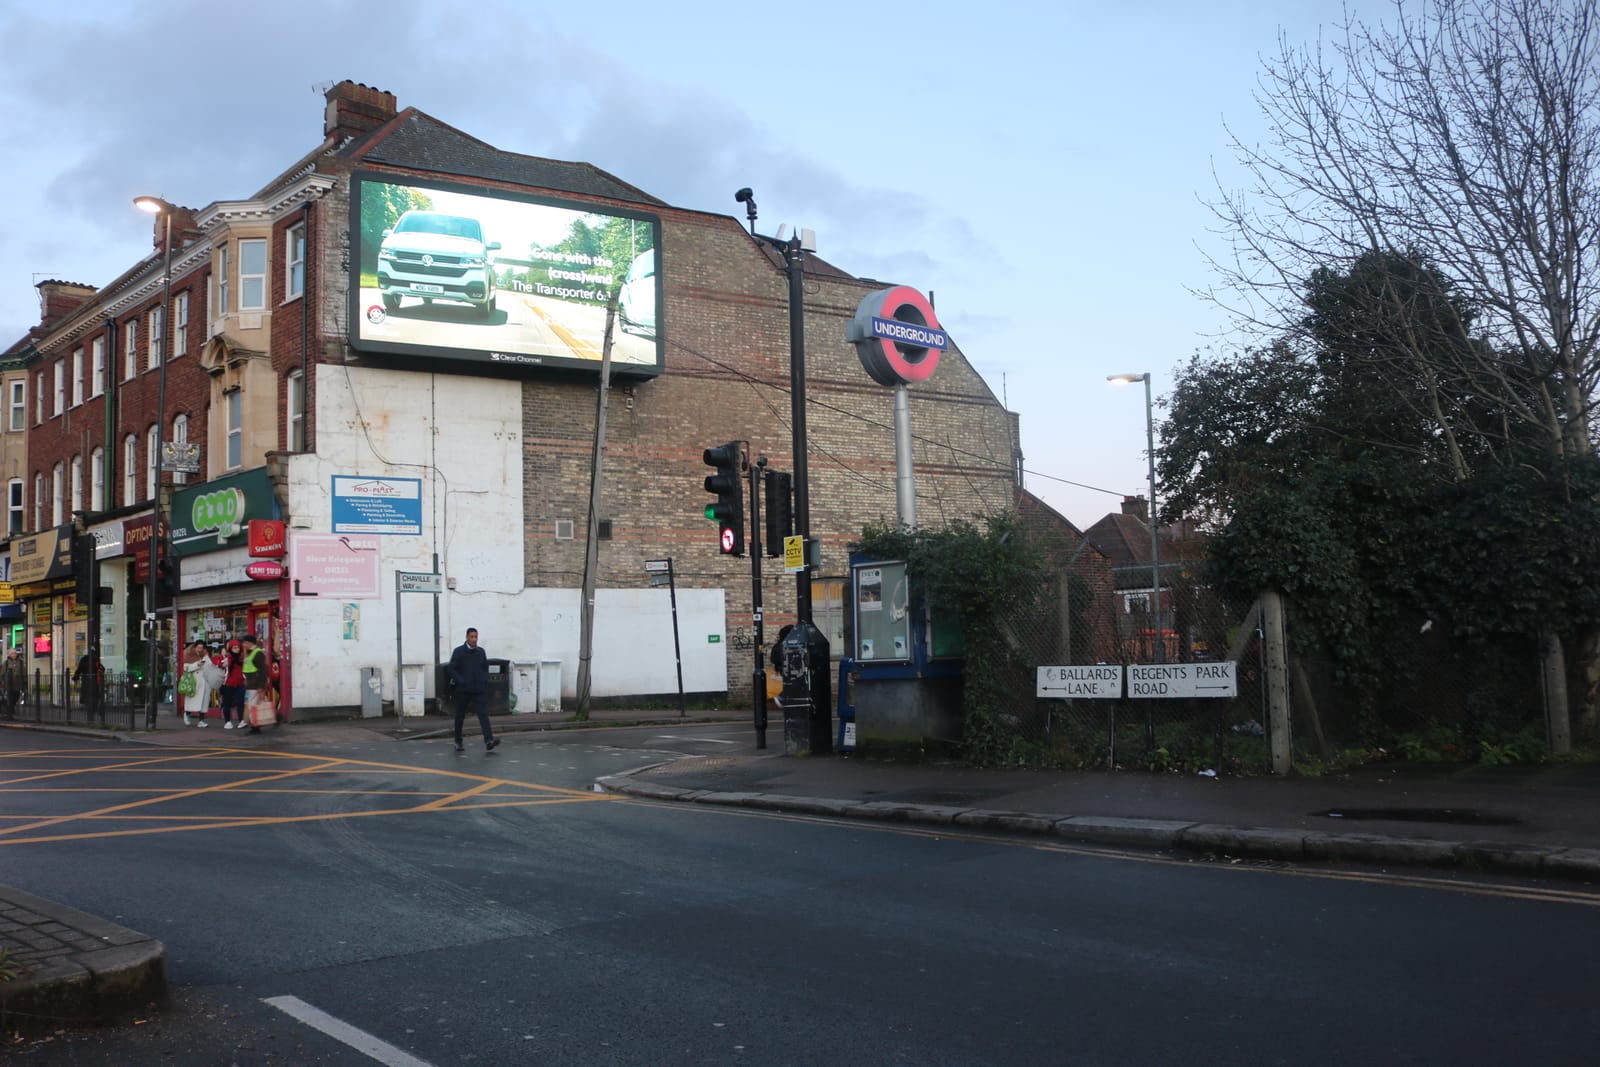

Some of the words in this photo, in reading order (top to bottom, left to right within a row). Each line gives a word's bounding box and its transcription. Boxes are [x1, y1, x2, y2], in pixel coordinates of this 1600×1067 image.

[532, 248, 563, 261] Gone
[565, 252, 591, 265] with
[593, 255, 613, 268] the
[548, 266, 613, 285] (cross)wind
[512, 280, 532, 292] The
[535, 282, 593, 300] Transporter
[874, 321, 944, 346] UNDERGROUND
[517, 355, 542, 363] Channel
[194, 491, 237, 529] FOOD
[126, 522, 164, 545] OPTICIAS
[786, 546, 802, 556] CCTV
[1060, 668, 1118, 680] BALLARDS
[1132, 667, 1187, 680] REGENTS
[1196, 665, 1230, 679] PARK
[1068, 682, 1098, 695] LANE
[1133, 682, 1168, 695] ROAD
